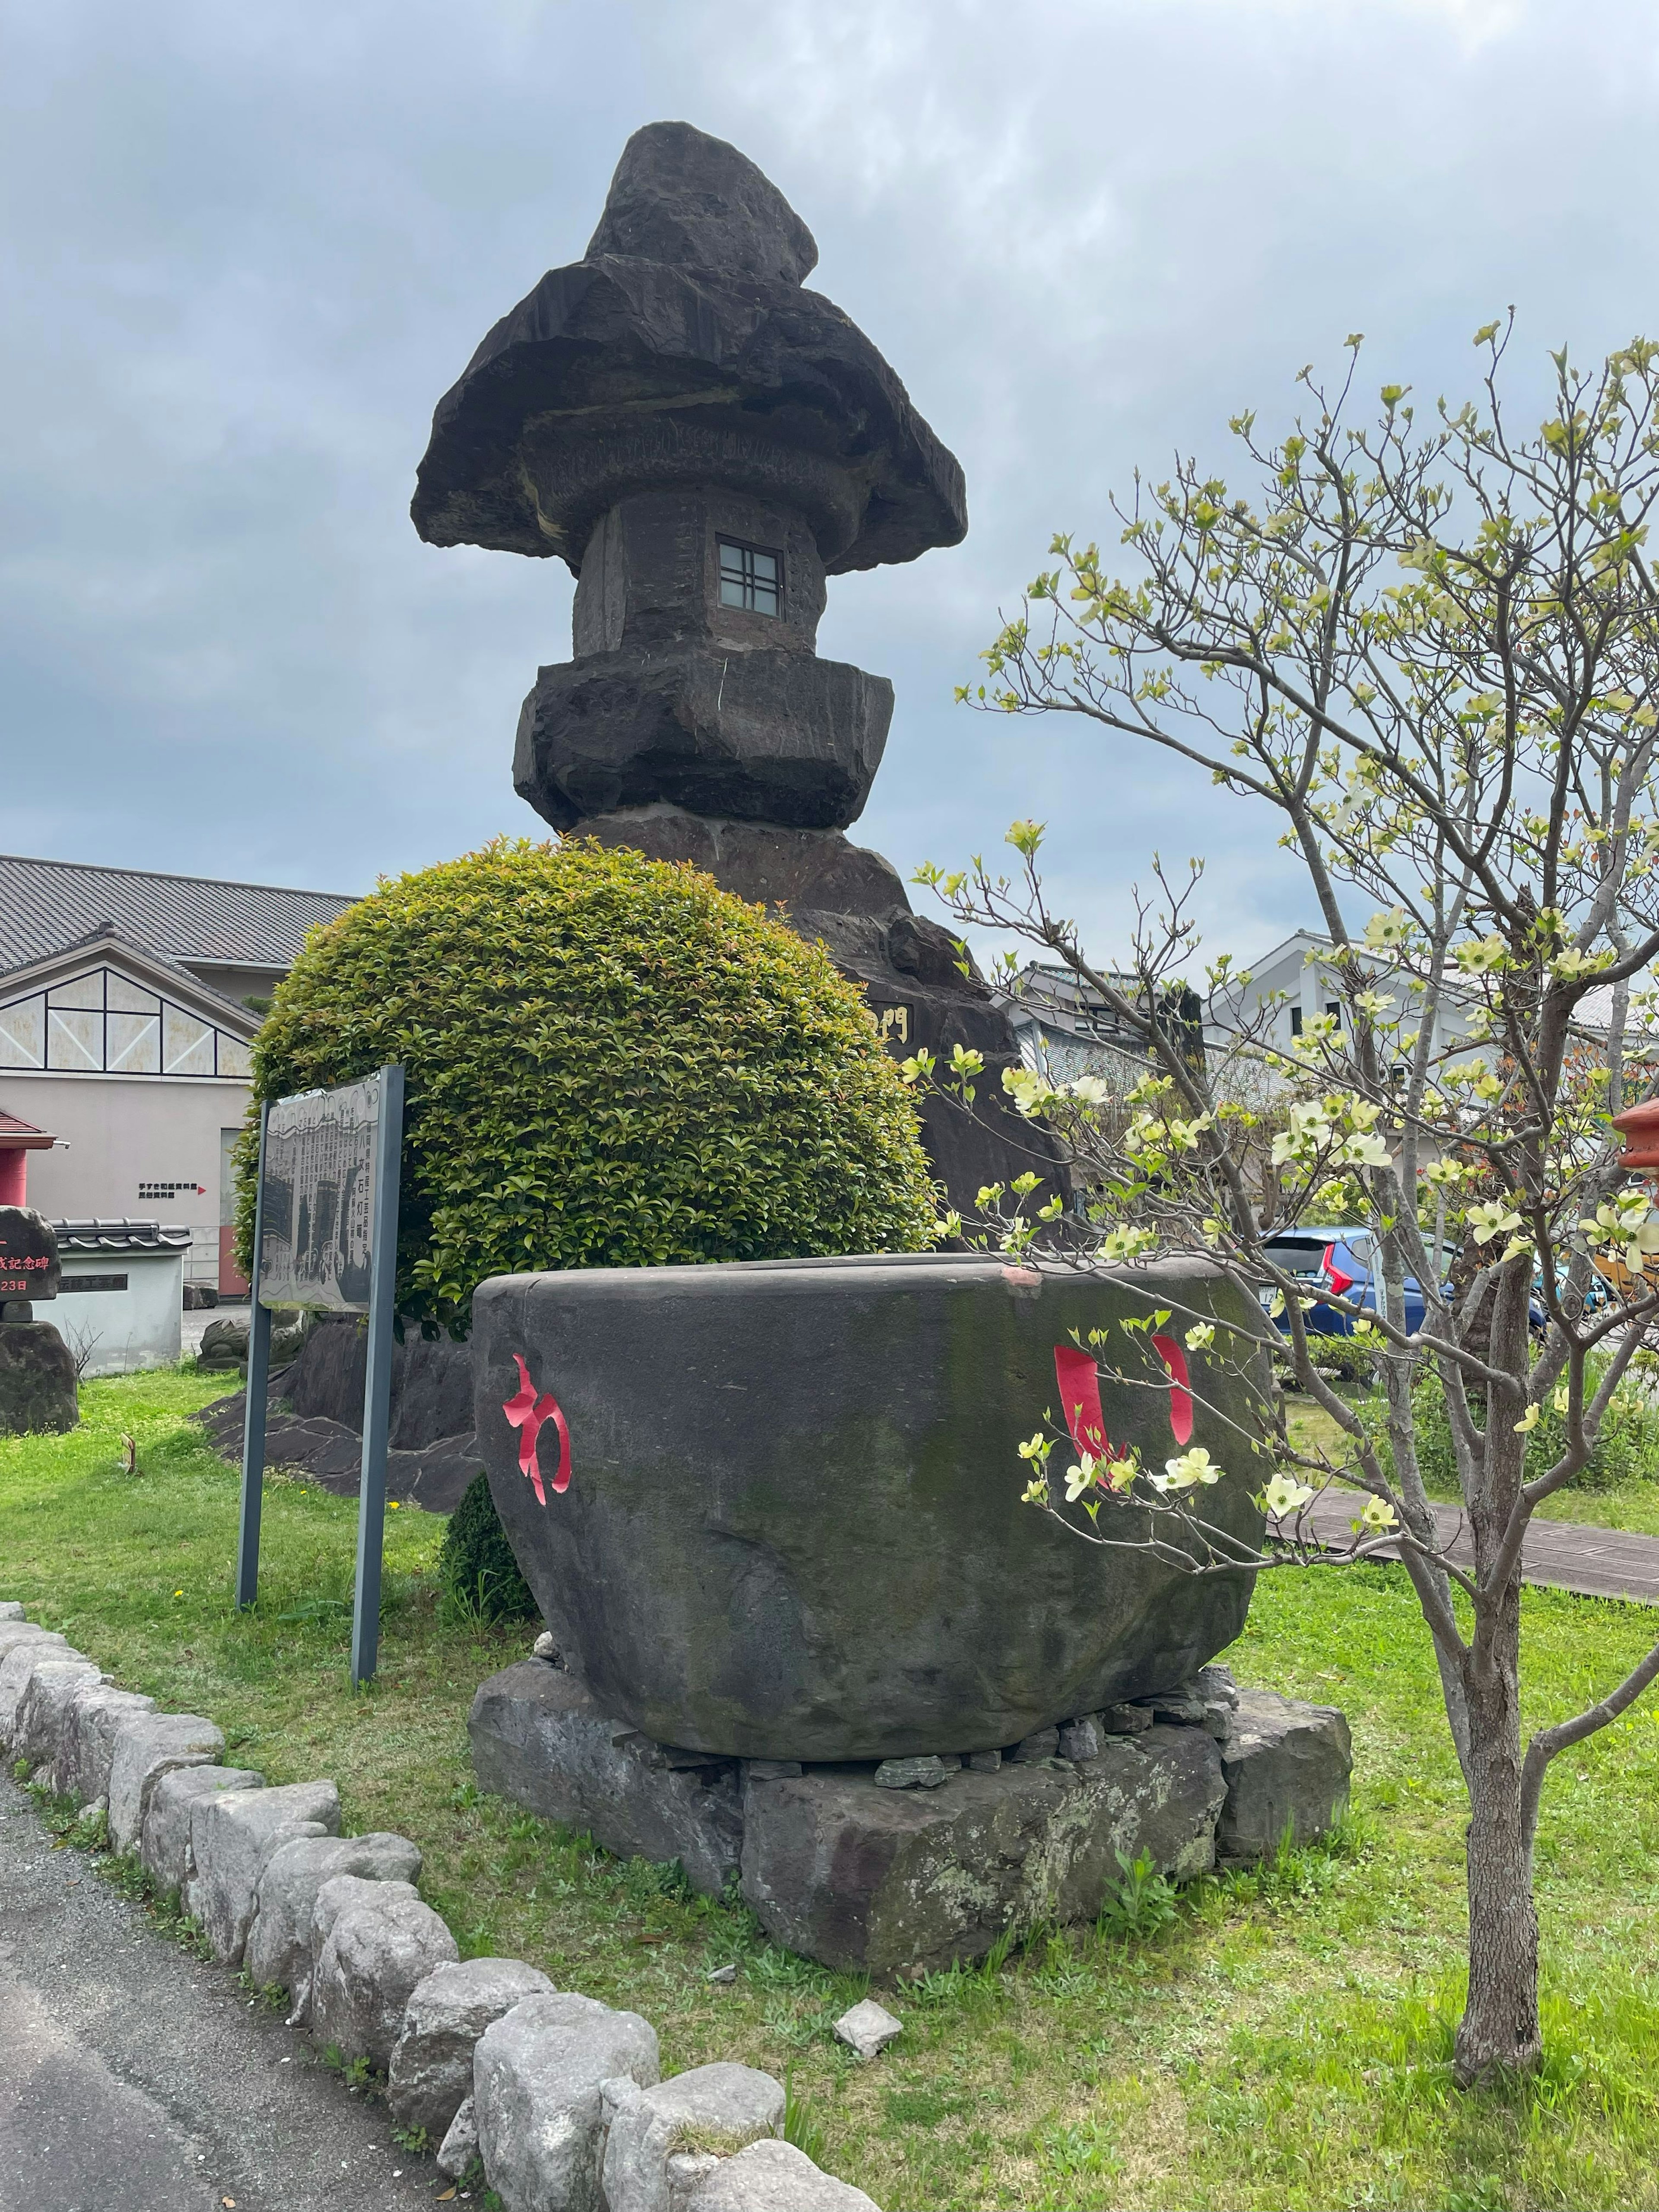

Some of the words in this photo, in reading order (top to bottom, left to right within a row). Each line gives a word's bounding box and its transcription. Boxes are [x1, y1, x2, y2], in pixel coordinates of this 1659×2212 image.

[356, 1135, 365, 1238] 八女石灯籠
[1, 1281, 27, 1291] 23日
[1265, 1294, 1273, 1303] 12
